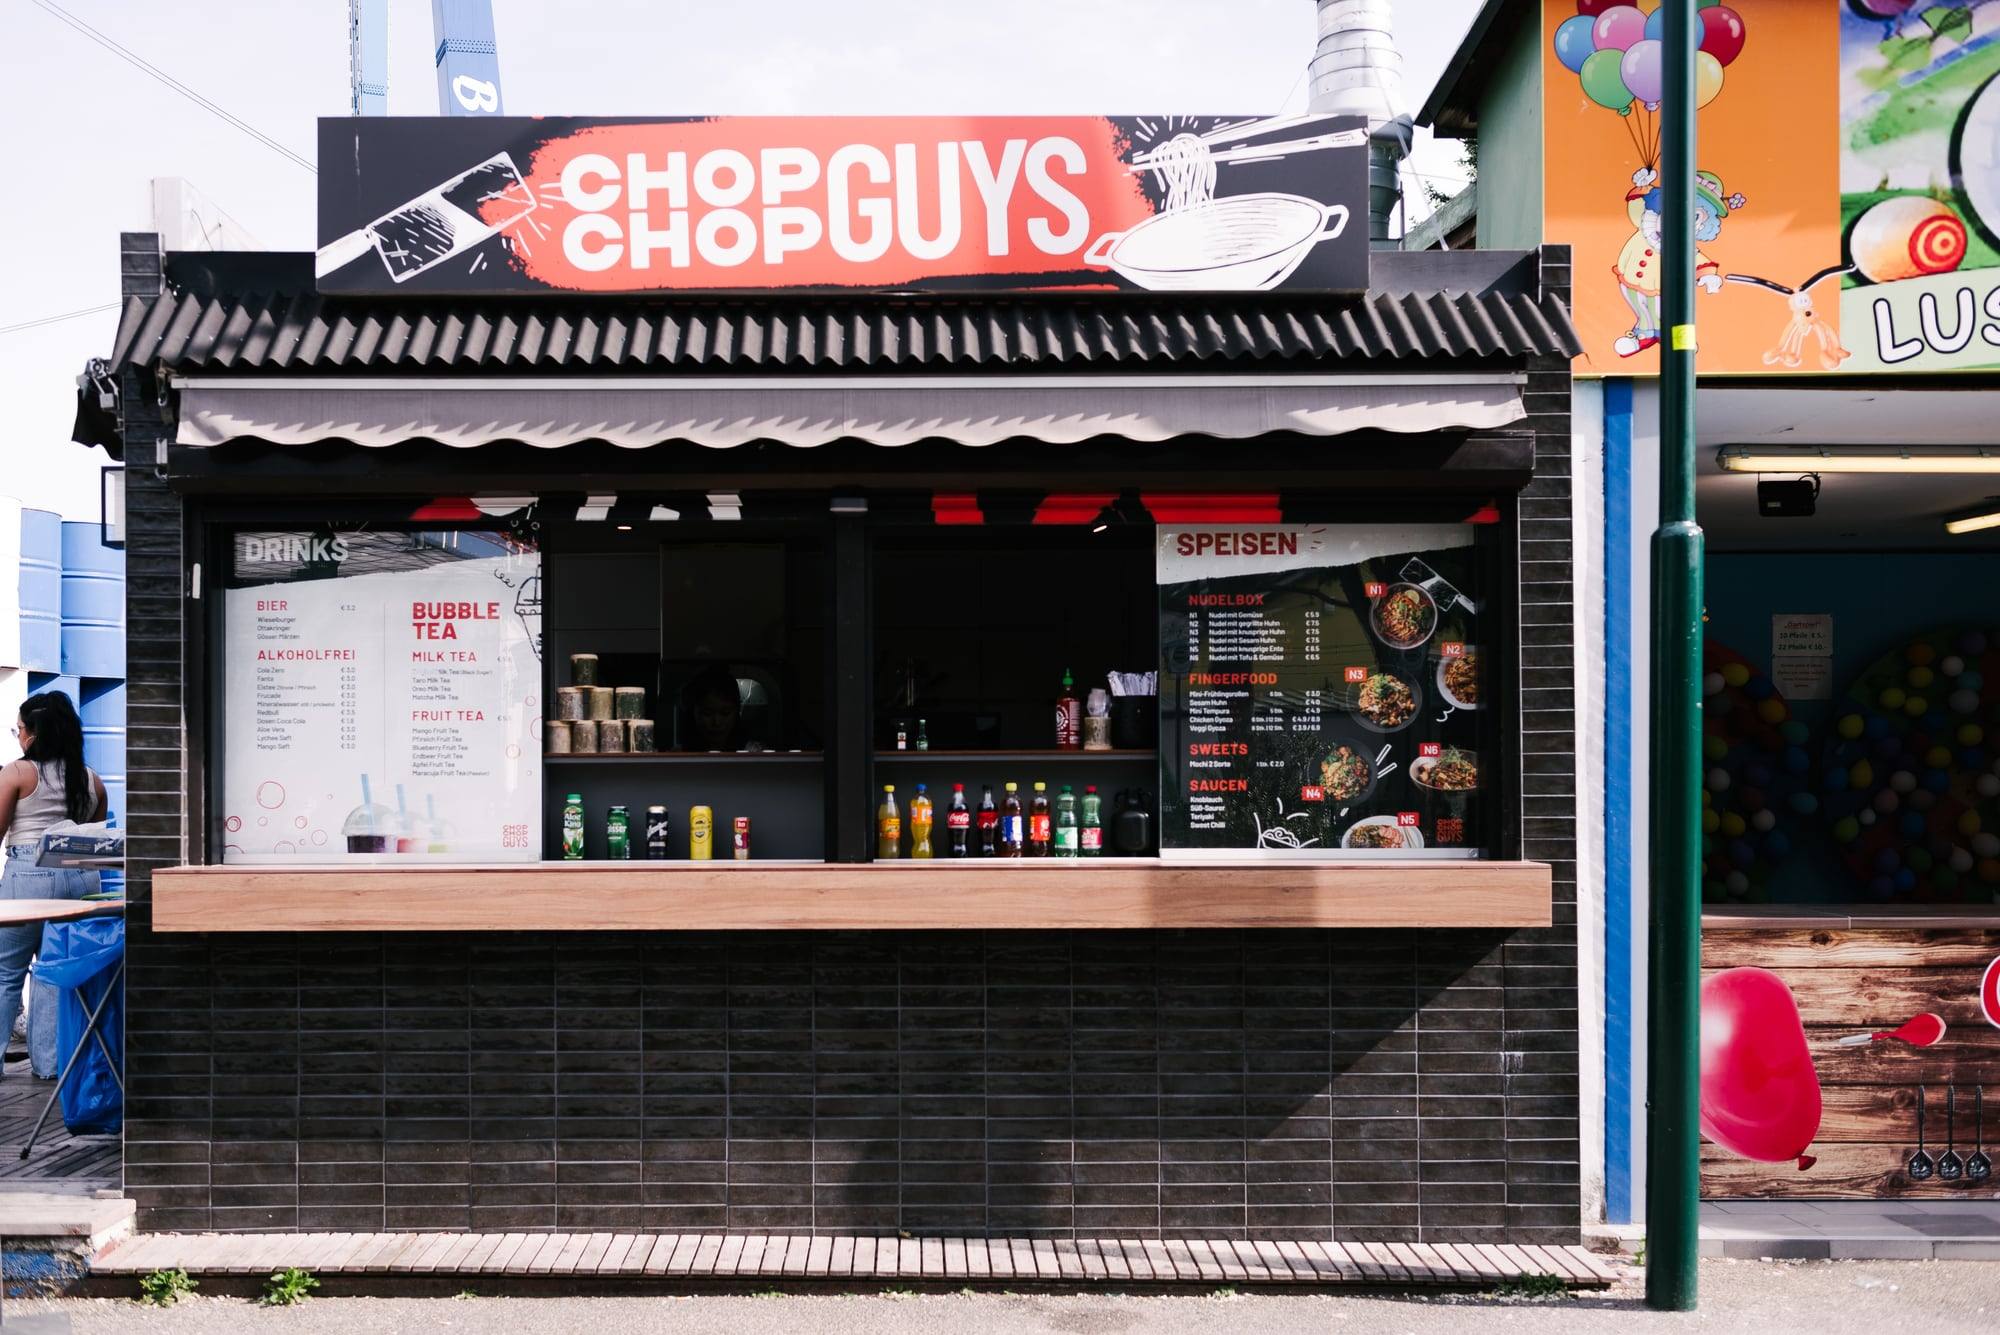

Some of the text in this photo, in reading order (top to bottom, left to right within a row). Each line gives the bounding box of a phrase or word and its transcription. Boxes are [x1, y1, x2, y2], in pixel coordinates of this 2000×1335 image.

[560, 147, 821, 212] CHOP
[827, 136, 1090, 263] GUYS
[562, 206, 823, 272] CHOP
[245, 538, 349, 562] DRINKS
[1176, 532, 1297, 556] SPEISEN
[1369, 586, 1382, 595] N1
[257, 600, 288, 611] BIER
[1188, 594, 1264, 606] NUDELBOX
[412, 602, 500, 620] BUBBLE
[412, 622, 457, 640] TEA
[257, 649, 356, 661] ALKOHOLFREI
[1446, 645, 1460, 655] N2
[412, 651, 477, 662] MILK TEA
[1189, 673, 1278, 685] FINGERFOOD
[1349, 670, 1363, 680] N3
[412, 710, 452, 721] FRUIT
[457, 710, 484, 721] TEA
[1189, 743, 1248, 756] SWEETS
[1424, 746, 1438, 755] N6
[1189, 779, 1247, 791] SAUCEN
[1306, 789, 1321, 799] N4
[1400, 815, 1415, 824] N5
[502, 836, 528, 848] GUYS
